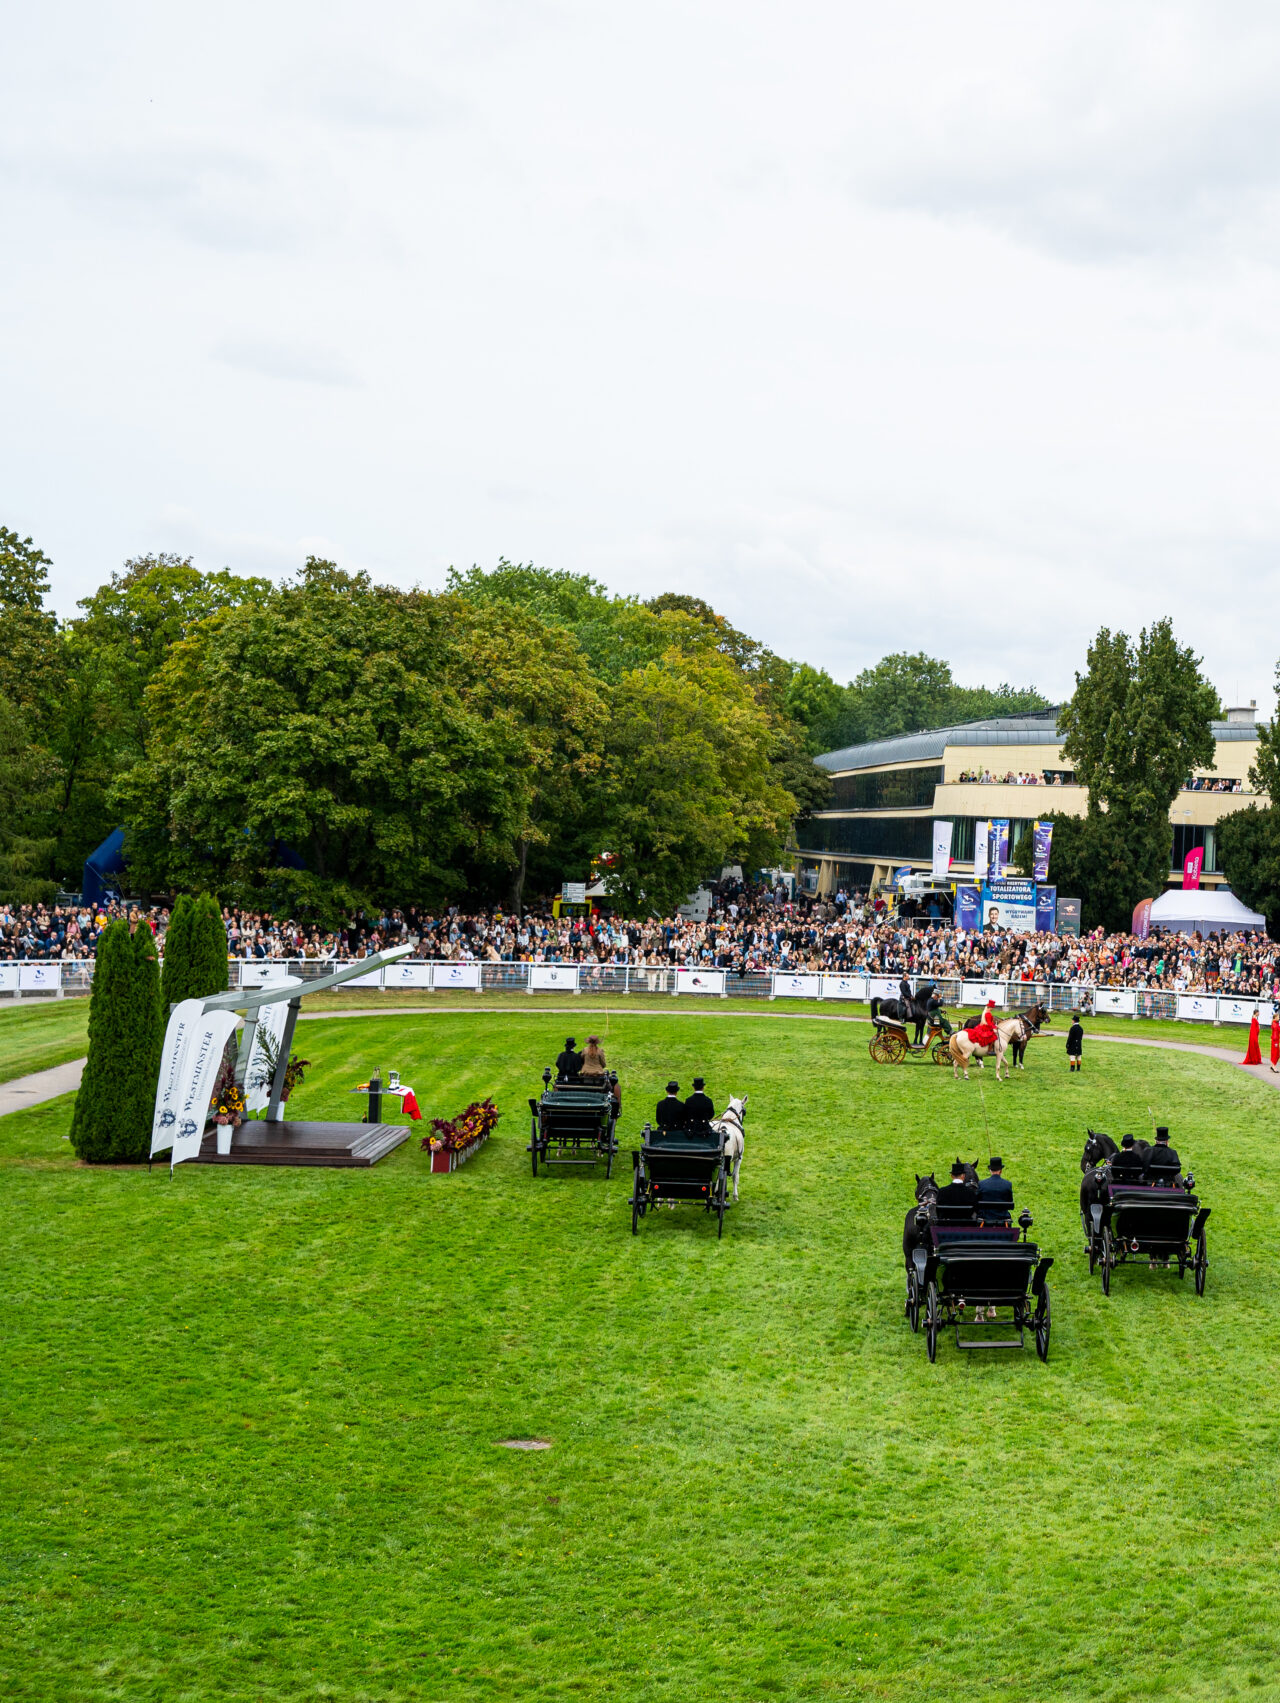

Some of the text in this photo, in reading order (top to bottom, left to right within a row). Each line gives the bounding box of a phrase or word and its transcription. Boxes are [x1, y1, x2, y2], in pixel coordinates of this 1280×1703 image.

[990, 885, 1031, 893] TOTALIZATORA
[992, 893, 1033, 901] SPORTOWEGO
[184, 1031, 213, 1112] WESTMINSTER
